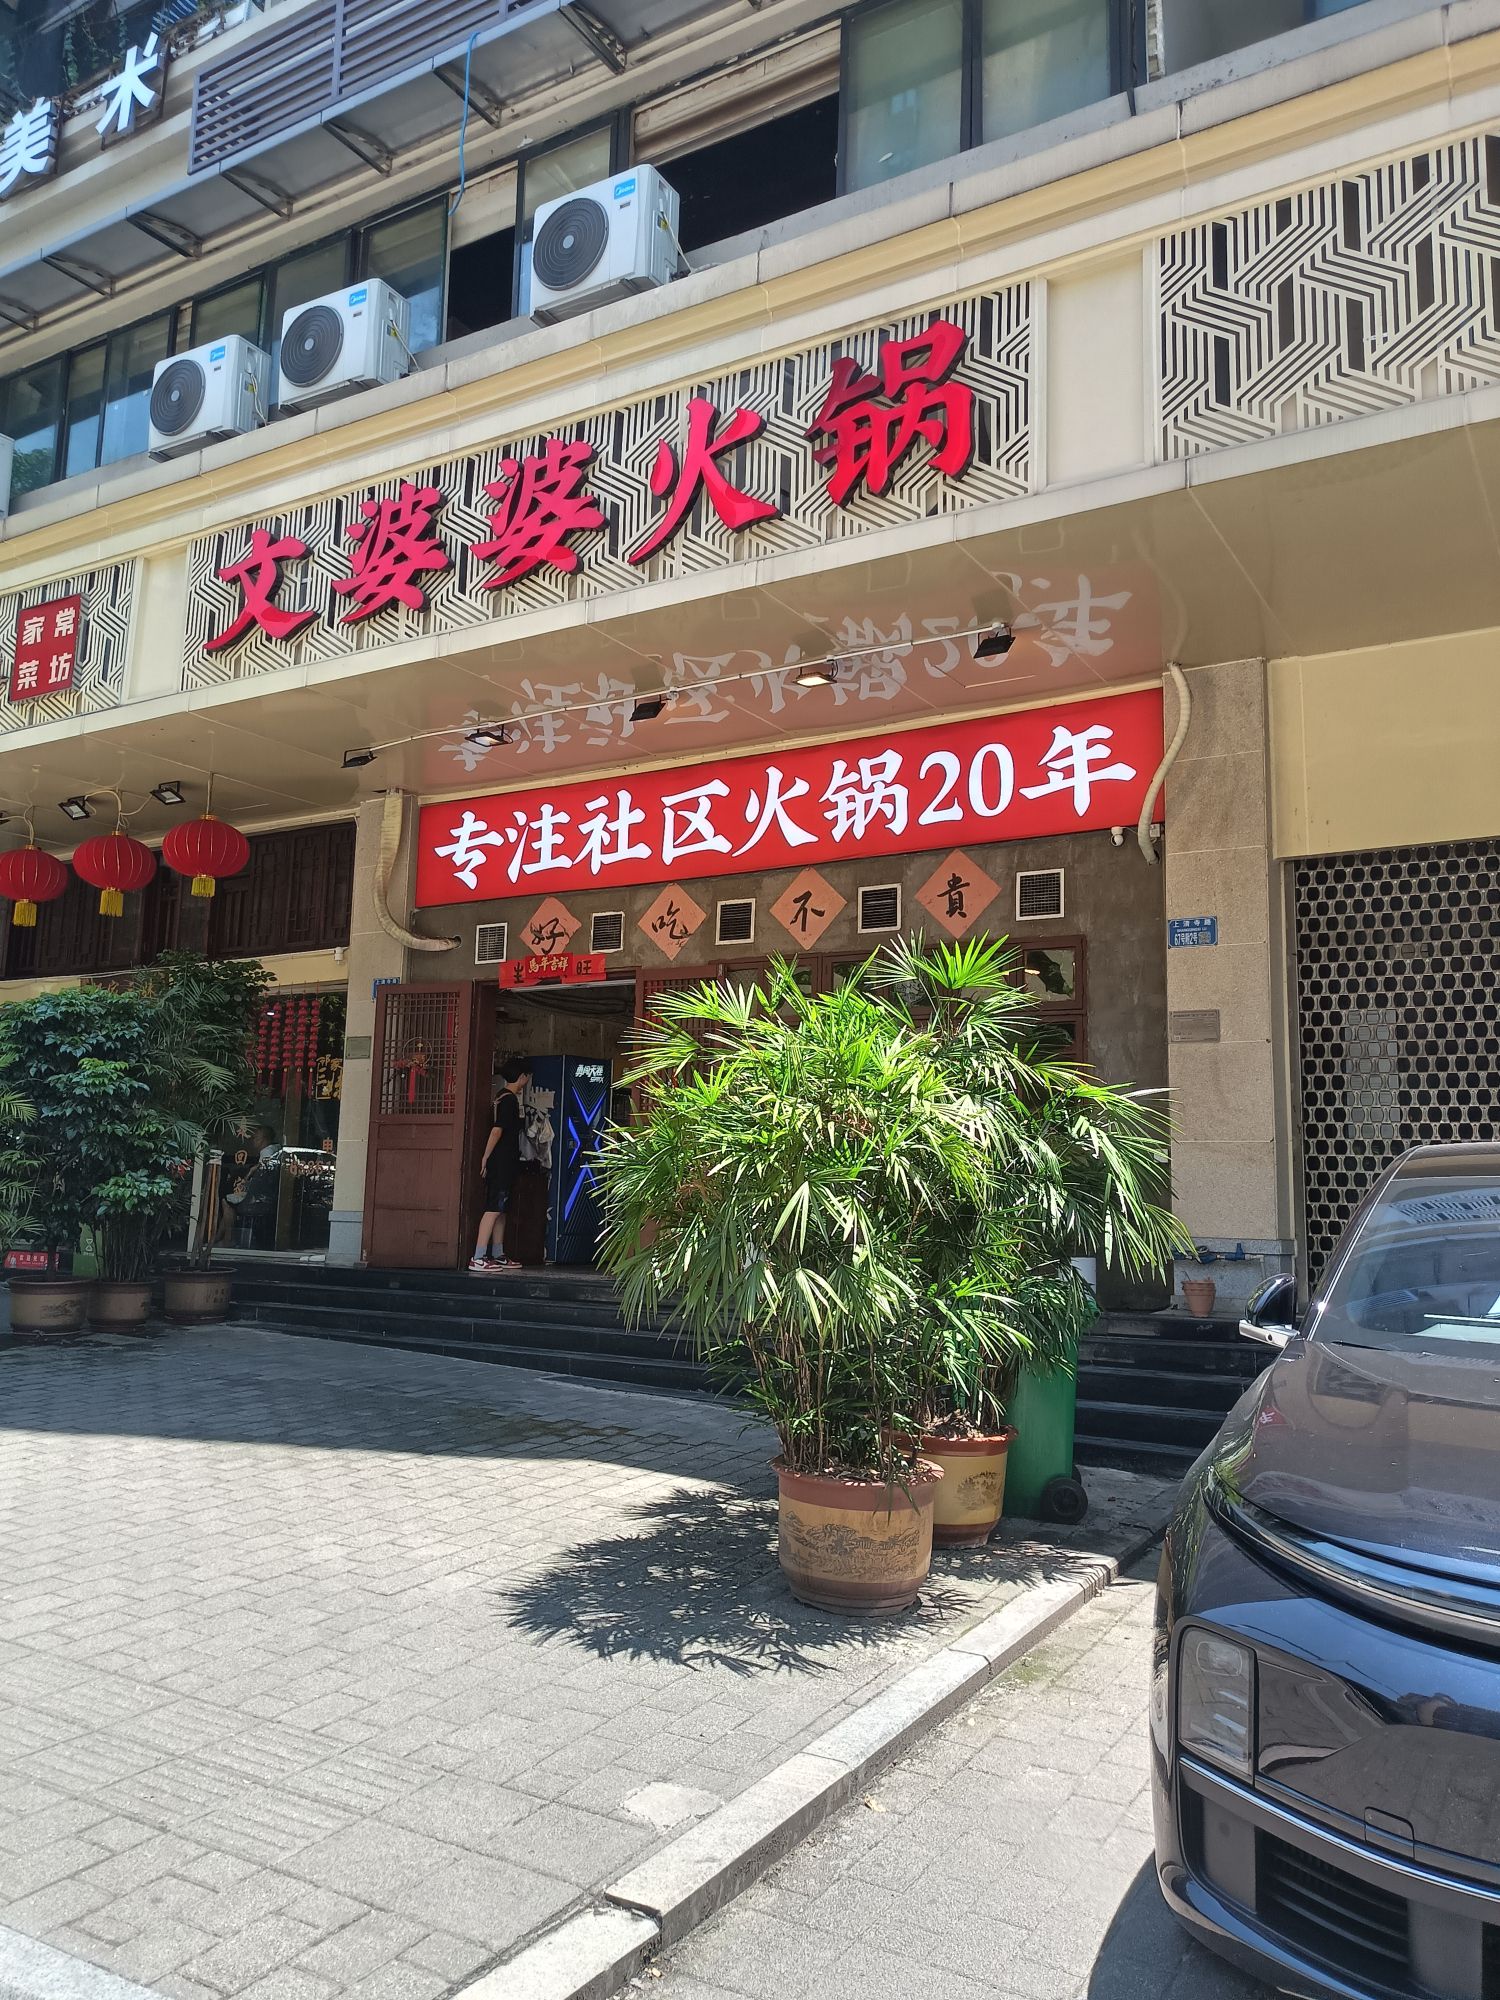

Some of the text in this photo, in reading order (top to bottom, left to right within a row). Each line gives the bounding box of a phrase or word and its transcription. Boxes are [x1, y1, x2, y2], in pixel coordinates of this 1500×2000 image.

[0, 31, 158, 194] 美术
[203, 319, 976, 653] 文婆婆火锅
[434, 724, 1137, 892] 专注社区火锅20年
